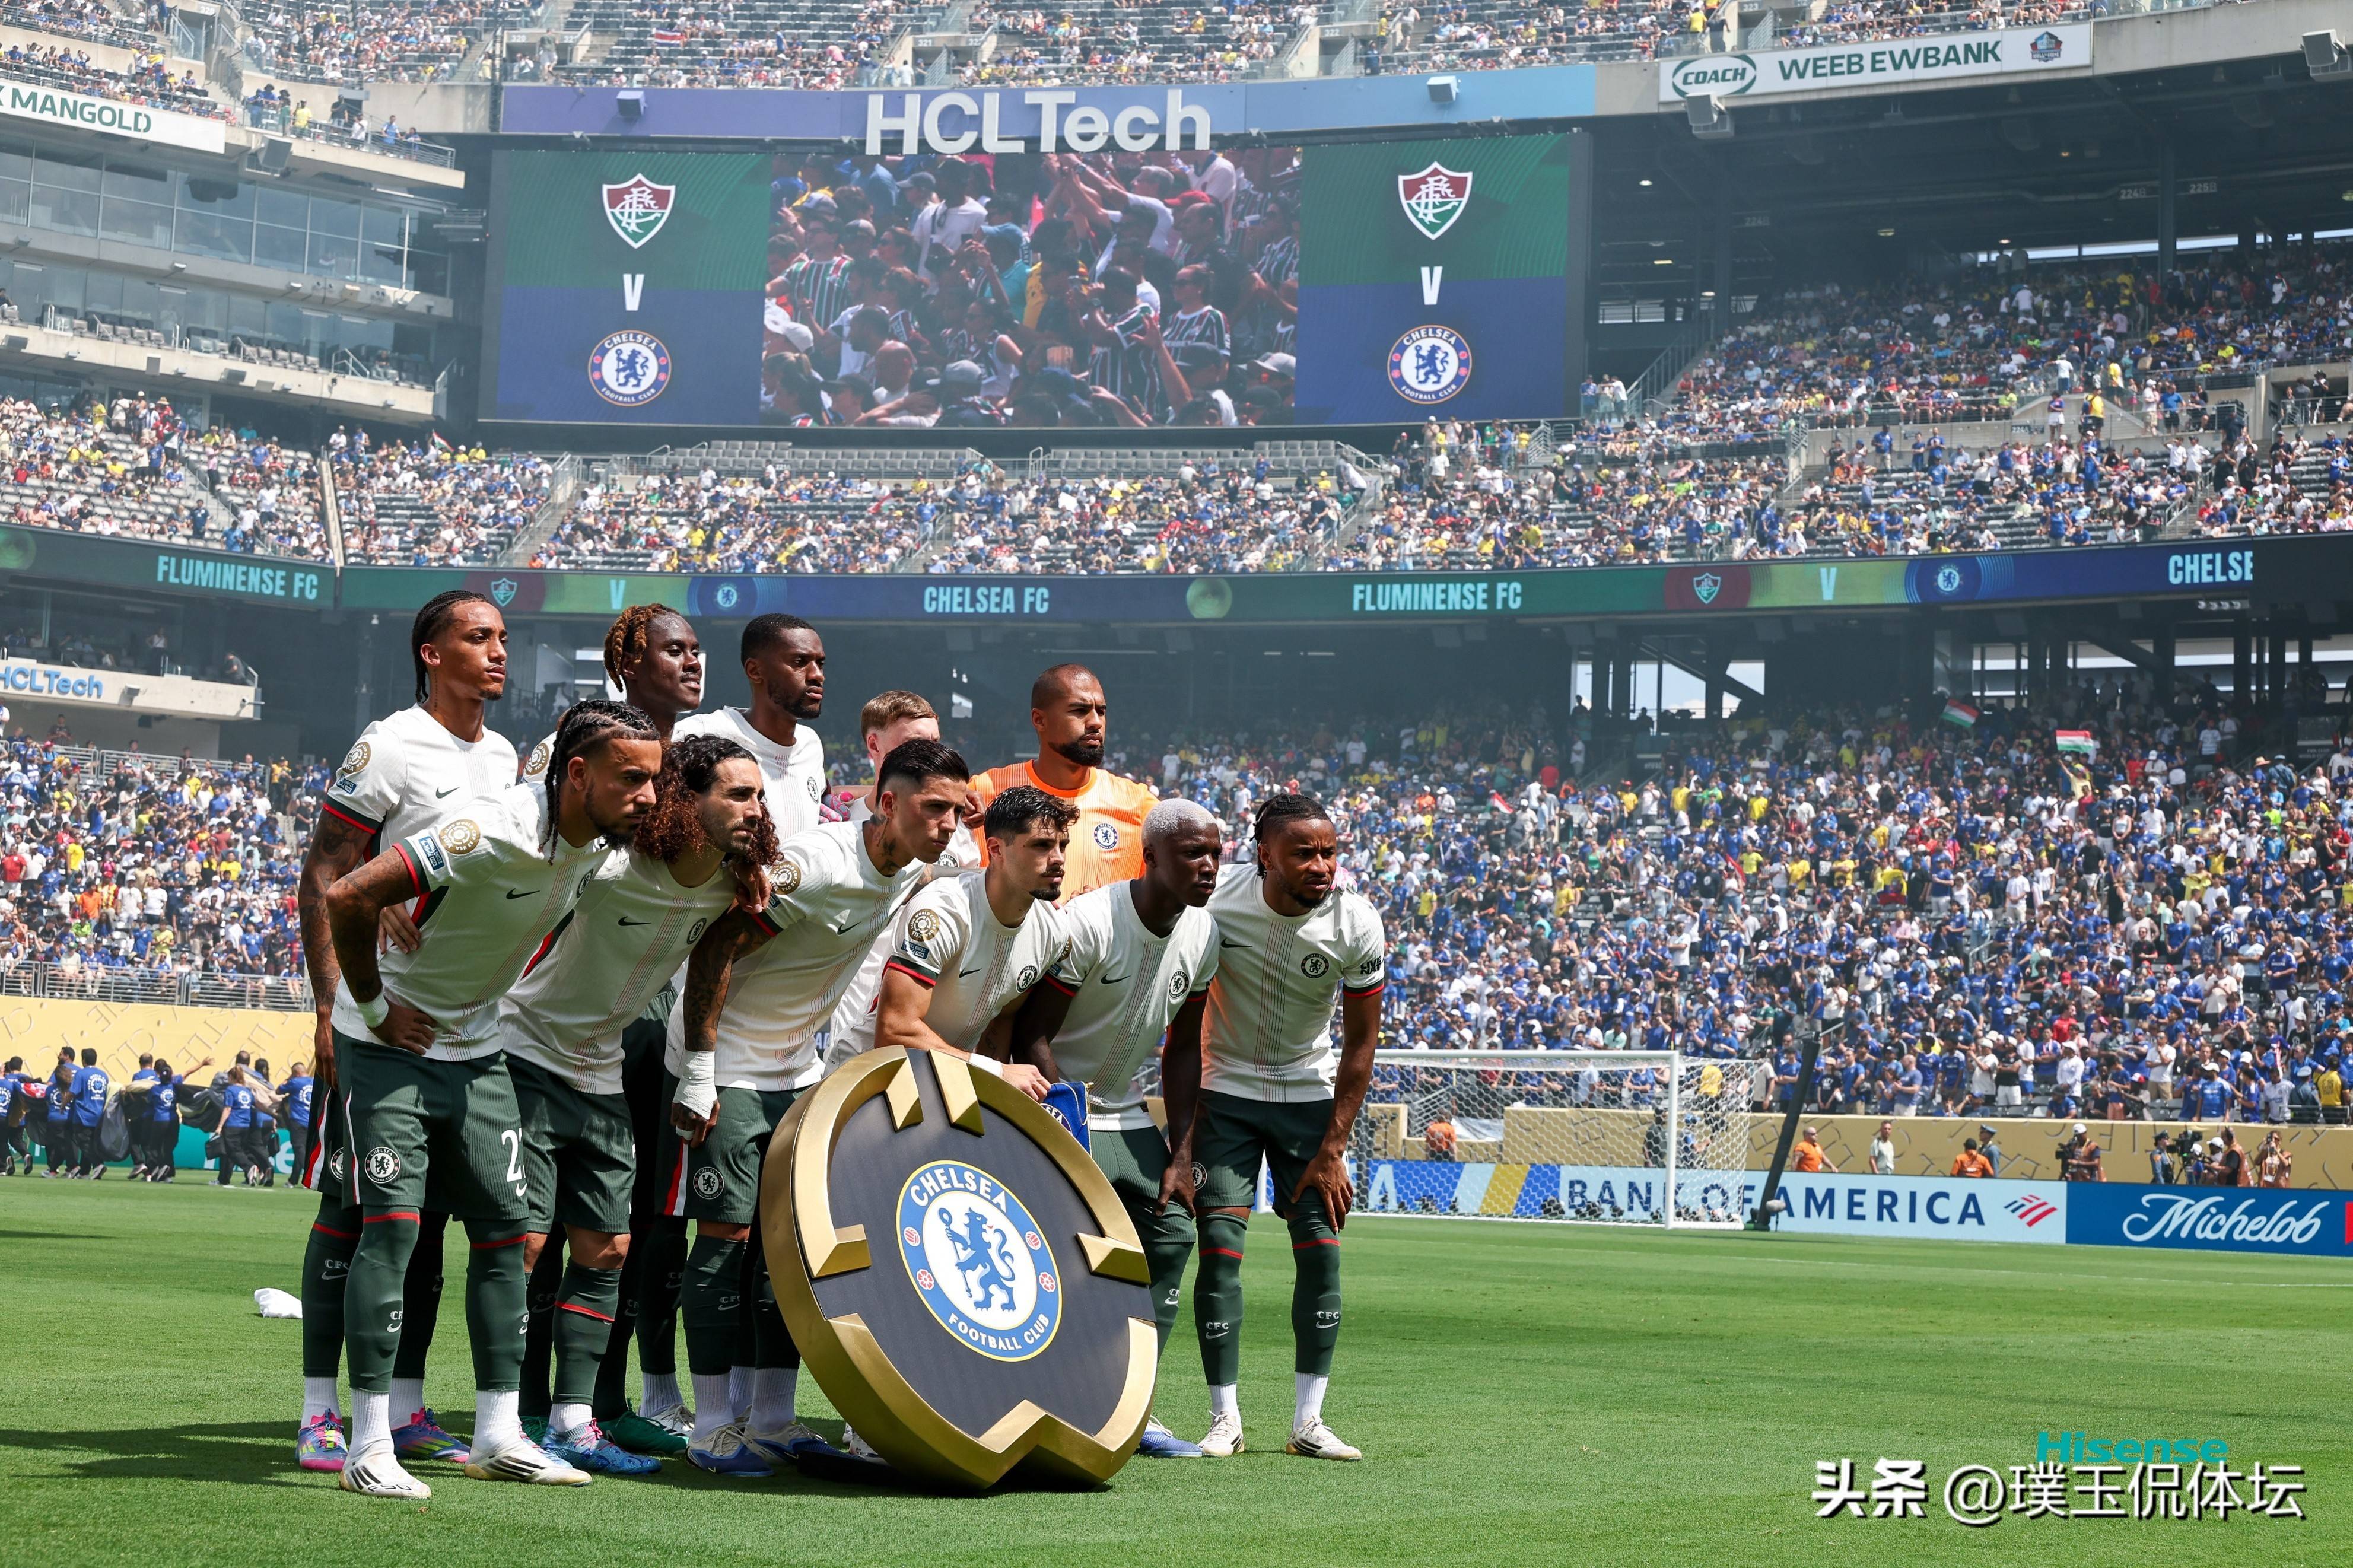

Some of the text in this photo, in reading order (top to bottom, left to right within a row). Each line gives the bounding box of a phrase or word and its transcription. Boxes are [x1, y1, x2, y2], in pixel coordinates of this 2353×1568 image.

[1682, 67, 1747, 85] COACH
[1778, 40, 2002, 81] WEEB EWBANK
[11, 88, 151, 133] MANGOLD
[865, 88, 1211, 155] HCLTech
[623, 274, 644, 311] V
[1420, 266, 1443, 305] V
[604, 333, 658, 351] CHELSEA
[1403, 328, 1457, 346] CHELSEA
[601, 387, 656, 402] FOOTBALL CLUB
[1401, 384, 1457, 400] FOOTBALL CLUB
[157, 555, 318, 600] FLUMINENSE FC
[1820, 567, 1837, 601] V
[610, 579, 626, 610] V
[924, 586, 1049, 613] CHELSEA FC
[1353, 581, 1522, 611] FLUMINENSE FC
[1360, 956, 1381, 969] LIVE
[370, 1148, 393, 1156] CHELSEA
[911, 1168, 1007, 1213] CHELSEA
[1775, 1185, 1986, 1226] AMERICA
[2122, 1193, 2330, 1244] Michelob
[949, 1313, 1050, 1350] FOOTBALL CLUB
[1317, 1311, 1340, 1320] CFC
